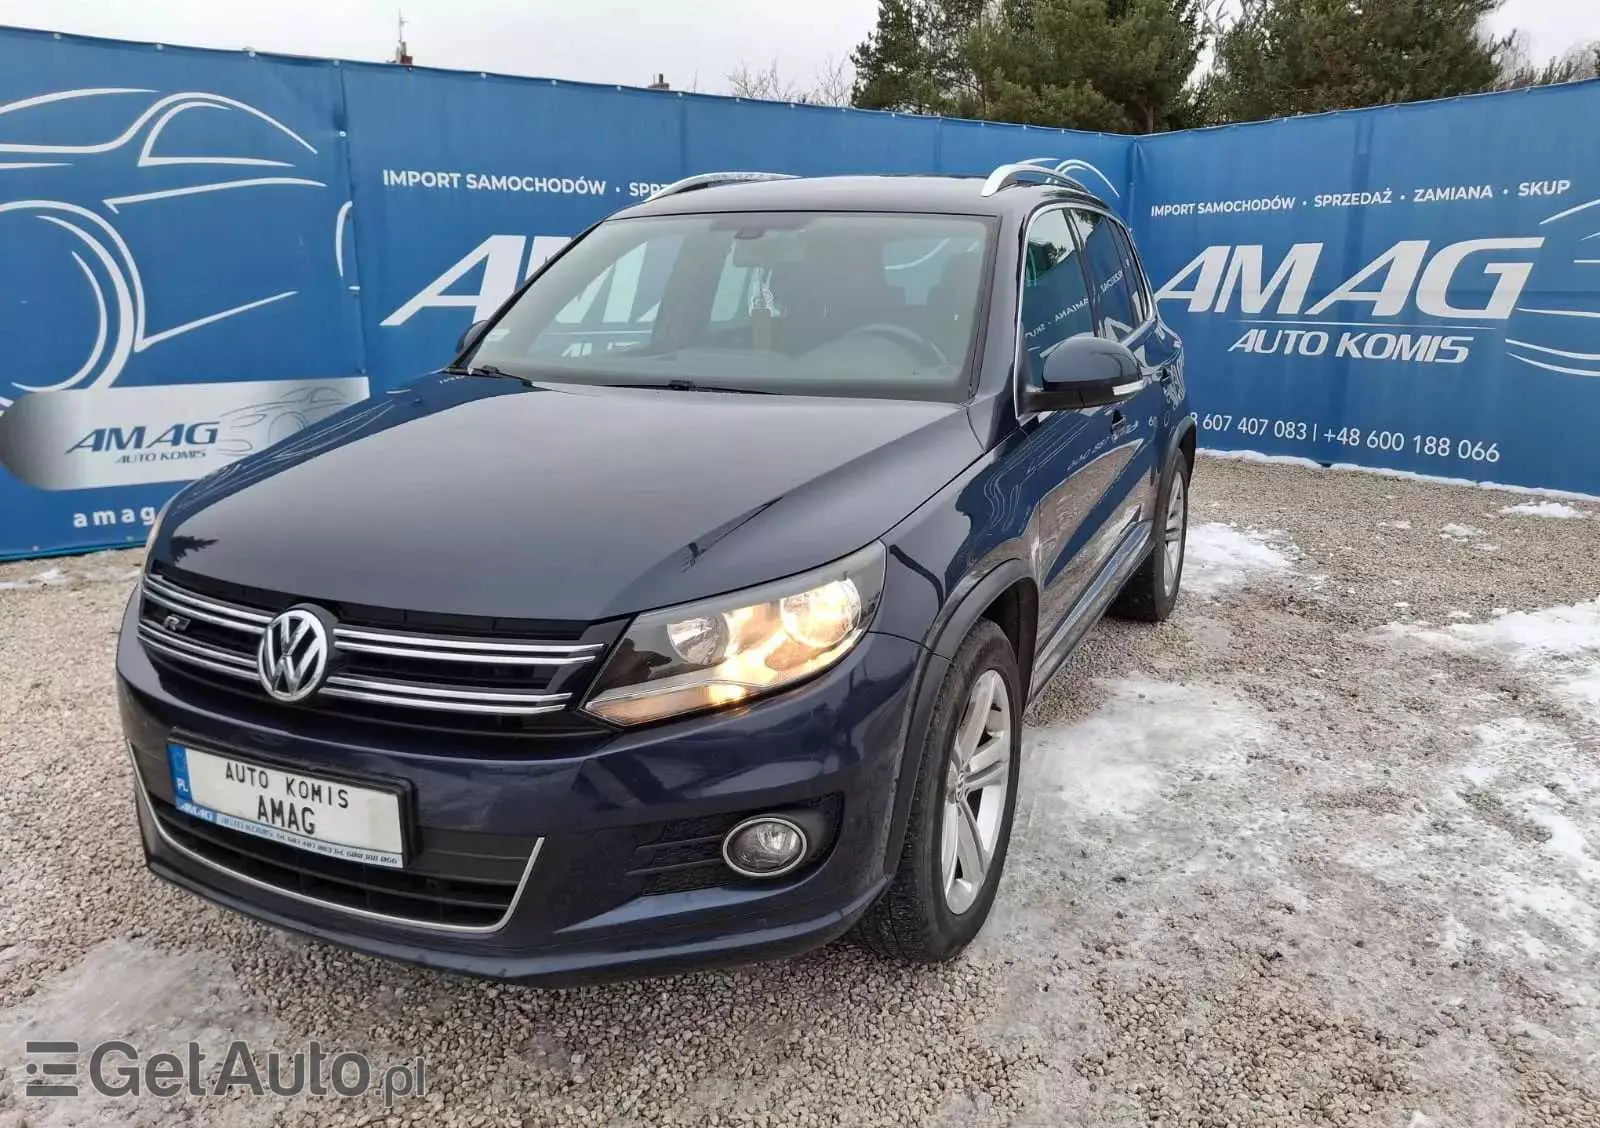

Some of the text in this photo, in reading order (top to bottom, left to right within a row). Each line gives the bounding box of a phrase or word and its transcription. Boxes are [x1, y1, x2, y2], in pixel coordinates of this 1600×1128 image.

[383, 169, 671, 197] IMPORT SAMOCHODÓW SPR
[1151, 179, 1570, 217] IMPORT SAMOCHODÓW SPRZEDAŻ ZAMIANA SKUP
[1227, 328, 1475, 364] AUTO KOMIS
[115, 449, 207, 464] AUTO KOMIS
[1203, 413, 1233, 431] 607
[1238, 416, 1269, 437] 407
[1274, 419, 1307, 440] 083
[1324, 426, 1360, 447] +48
[1366, 430, 1405, 452] 600
[1413, 434, 1450, 458] 188
[1457, 439, 1500, 463] 066
[225, 762, 349, 809] AUTO KOMIS
[257, 795, 316, 835] AMAG
